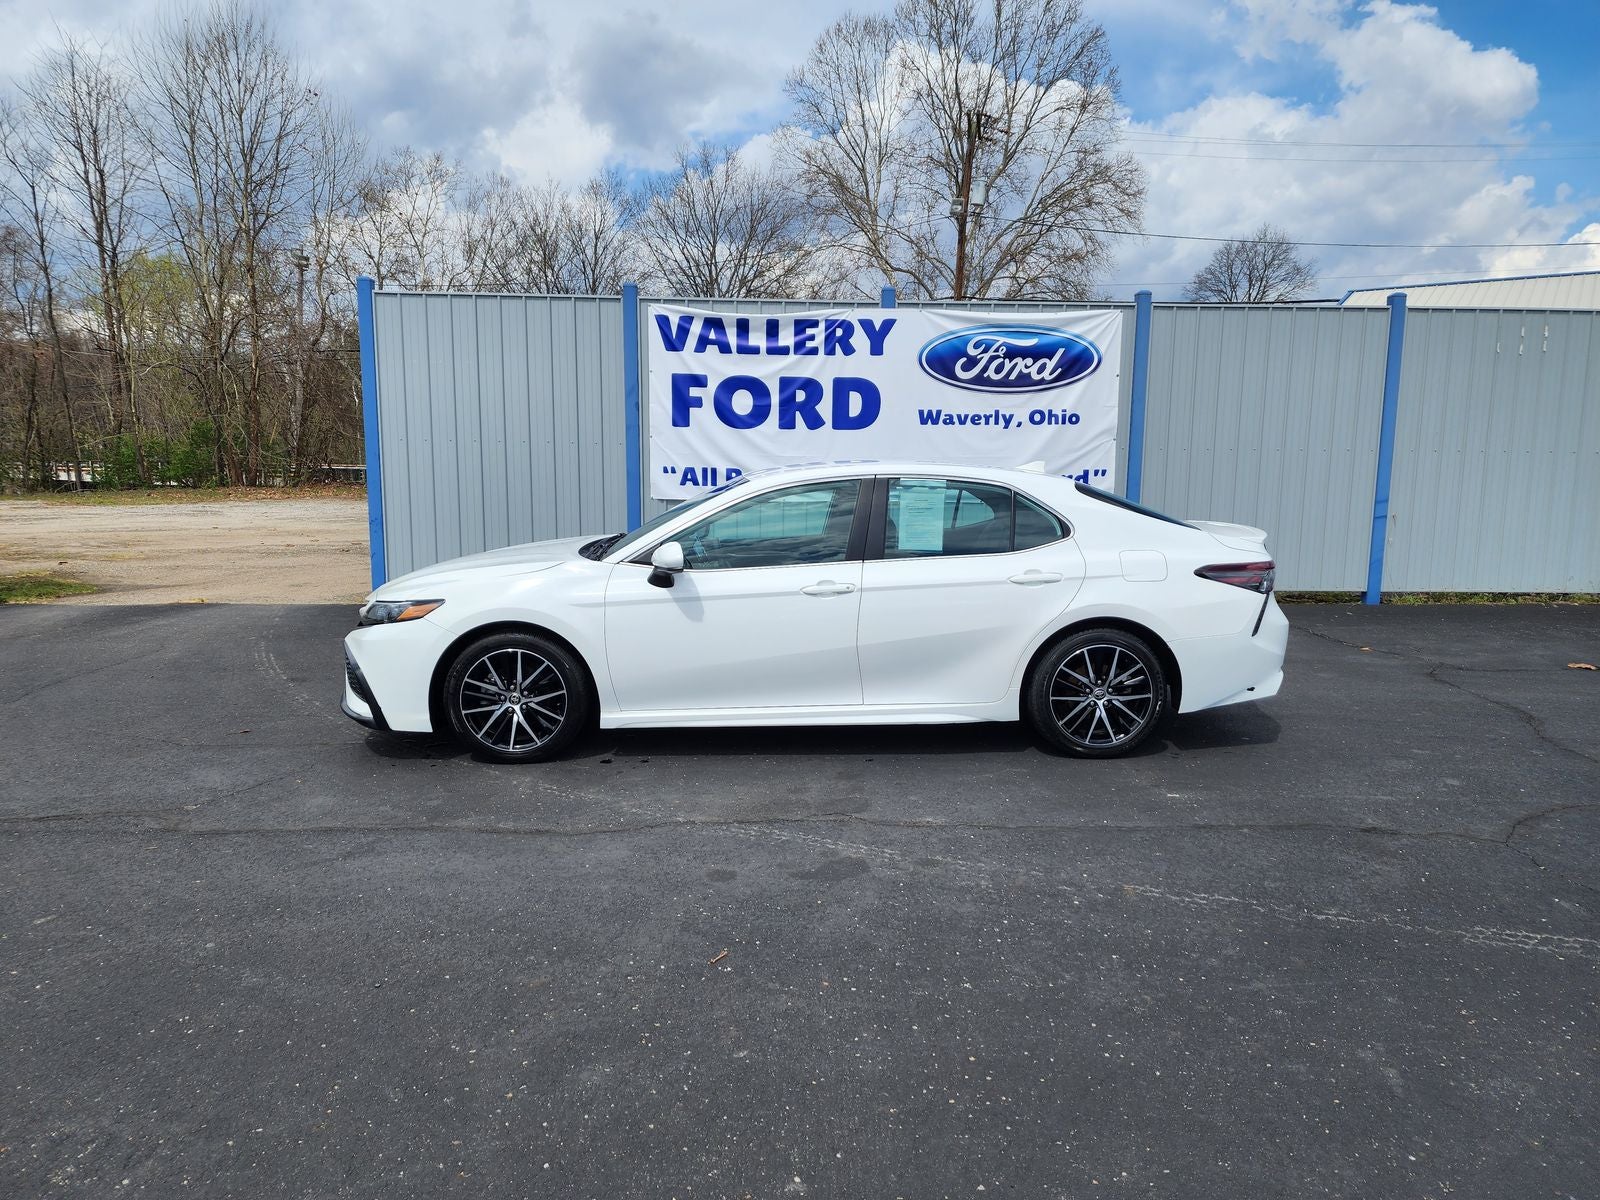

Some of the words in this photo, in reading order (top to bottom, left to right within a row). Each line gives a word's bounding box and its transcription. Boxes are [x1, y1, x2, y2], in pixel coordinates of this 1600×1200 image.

[654, 313, 897, 357] VALLERY
[954, 335, 1066, 381] Ford
[671, 372, 882, 431] FORD
[917, 409, 1023, 430] Waverly,
[1028, 408, 1081, 426] Ohio
